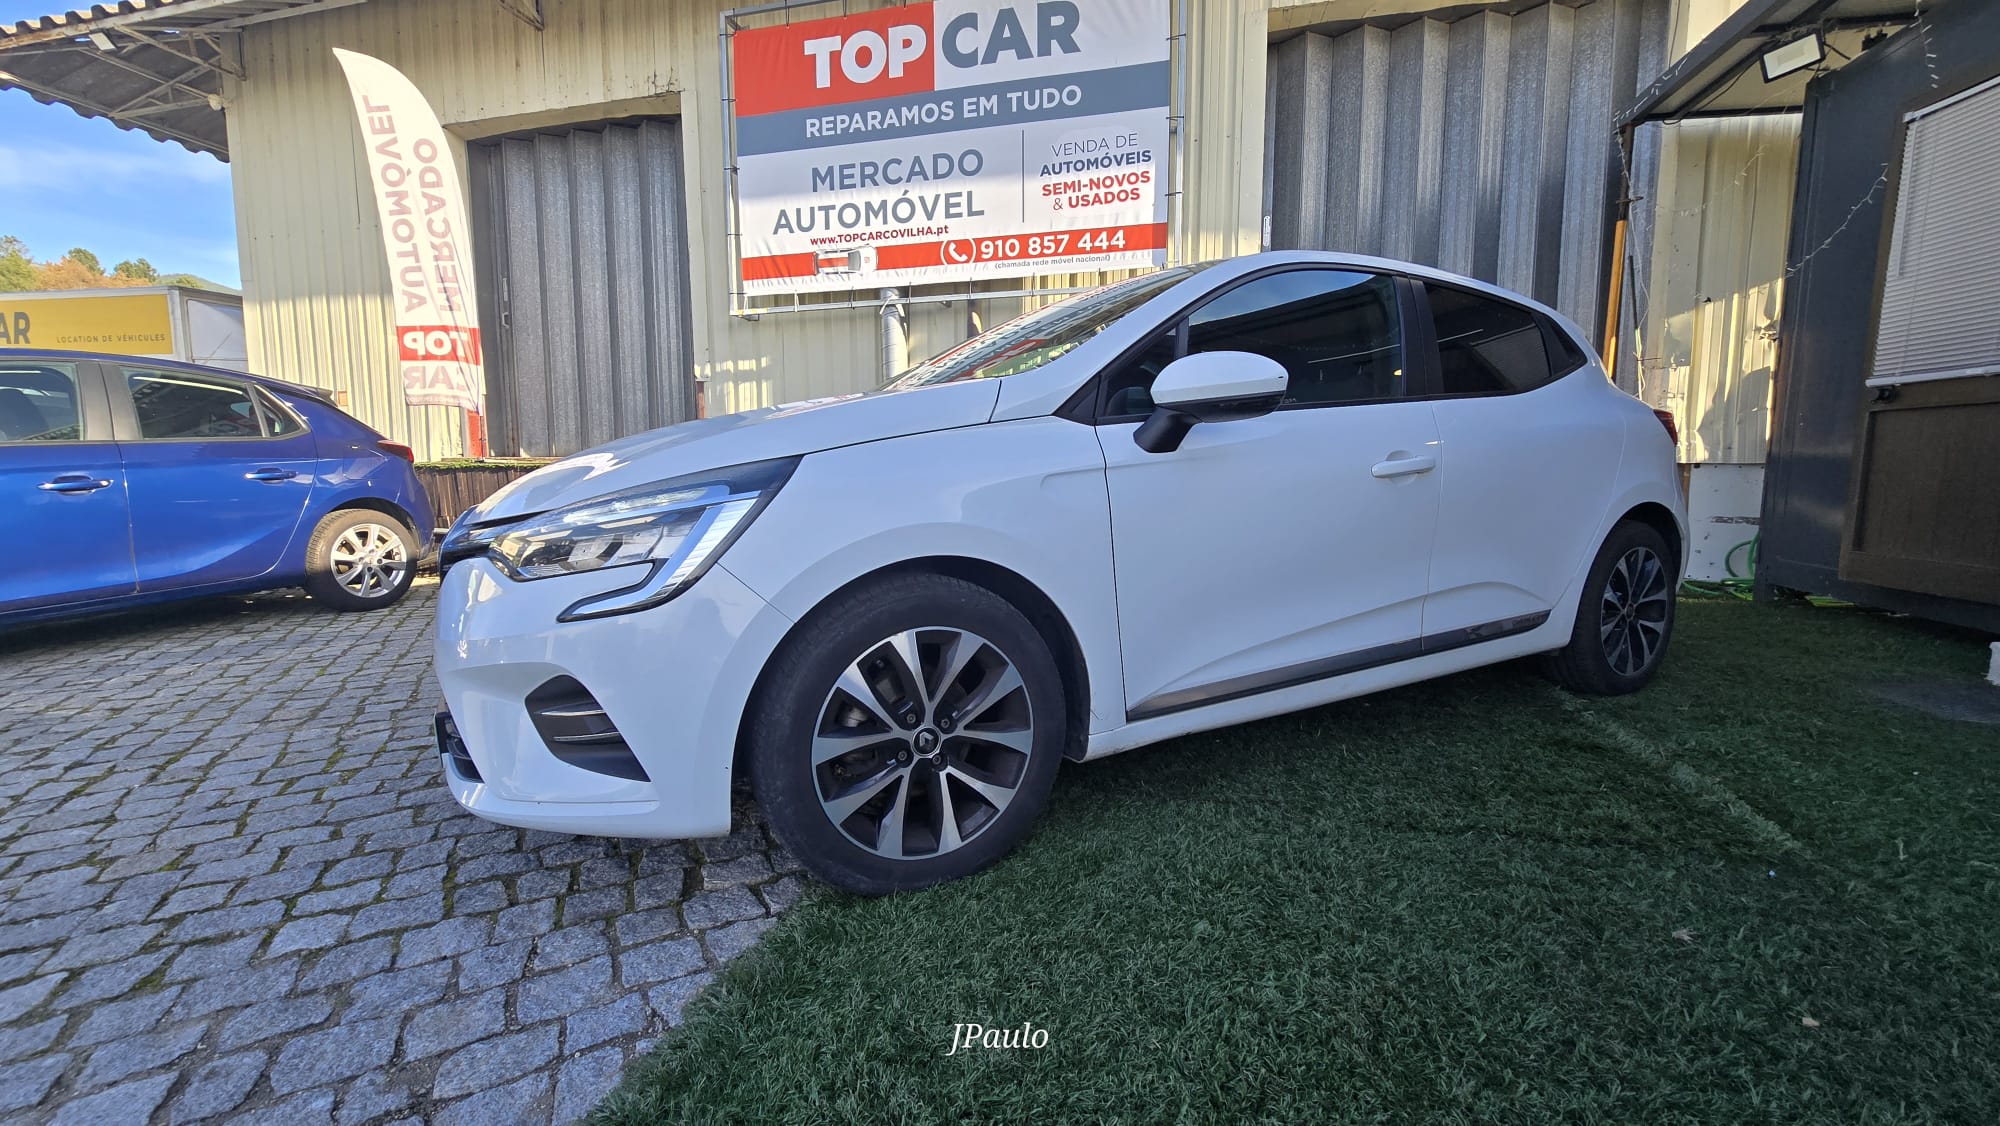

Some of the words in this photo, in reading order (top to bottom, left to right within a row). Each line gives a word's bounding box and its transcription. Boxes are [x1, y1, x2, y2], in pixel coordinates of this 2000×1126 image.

[803, 24, 928, 89] TOP
[941, 0, 1082, 69] CAR
[805, 100, 955, 138] REPARAMOS
[963, 94, 998, 119] EM
[1006, 85, 1082, 113] TUDO
[1051, 137, 1110, 157] VENDA
[1115, 132, 1138, 149] DE
[811, 149, 984, 193] MERCADO
[1040, 149, 1152, 177] AUTOMÓVEIS
[1041, 170, 1151, 197] SEMI-NOVOS
[772, 189, 985, 235] AUTOMÓVEL
[1052, 197, 1064, 211] &
[1068, 187, 1141, 209] USADOS
[810, 224, 949, 246] www.TOPCARCOVILHA.pt
[980, 238, 1020, 259] 910
[1027, 234, 1070, 256] 857
[1077, 229, 1126, 251] 444
[994, 261, 1031, 270] (chamada
[1032, 259, 1049, 267] rede
[1051, 256, 1074, 265] móvel
[56, 335, 99, 344] LOCATION
[101, 334, 113, 343] DE
